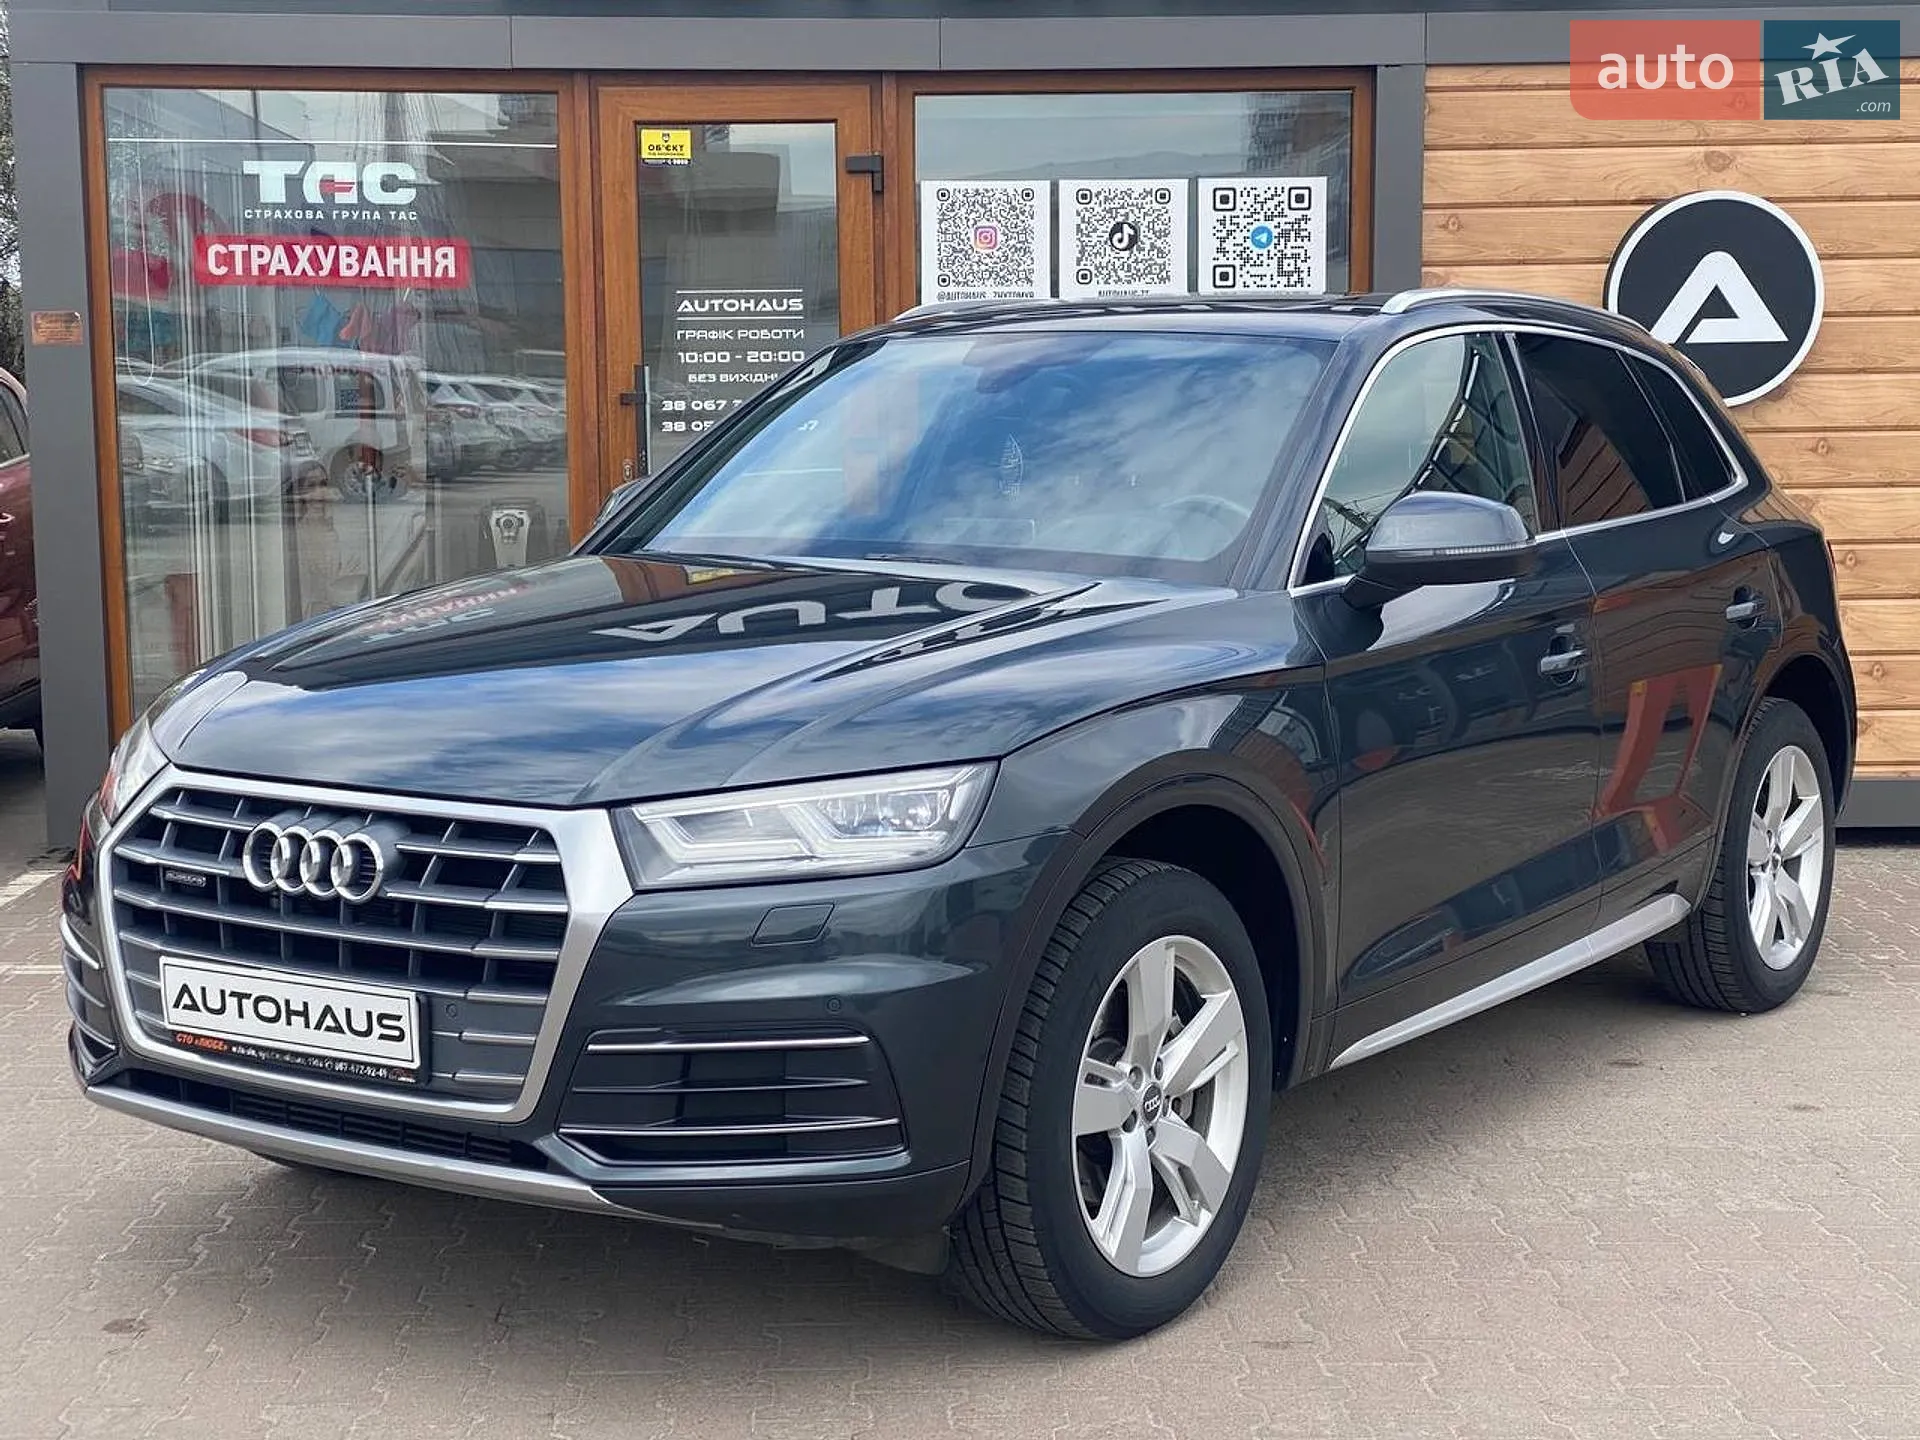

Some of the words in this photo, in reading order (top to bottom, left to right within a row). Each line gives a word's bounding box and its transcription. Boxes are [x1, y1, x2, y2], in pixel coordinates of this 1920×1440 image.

[244, 209, 324, 219] СТРАХОВА
[332, 210, 381, 220] ГРУПА
[389, 211, 418, 221] ТАС
[206, 242, 457, 278] СТРАХУВАННЯ
[676, 298, 804, 313] AUTOHAUS
[676, 329, 734, 341] ГРАФІК
[738, 328, 805, 340] РОБОТИ
[677, 351, 731, 364] 10:00
[746, 351, 805, 363] 20:00
[688, 373, 715, 383] БЕЗ
[719, 373, 778, 384] ВИХІДН
[661, 400, 686, 411] 38
[691, 400, 727, 411] 067
[661, 421, 686, 432] 38
[171, 982, 406, 1042] AUTOHAUS
